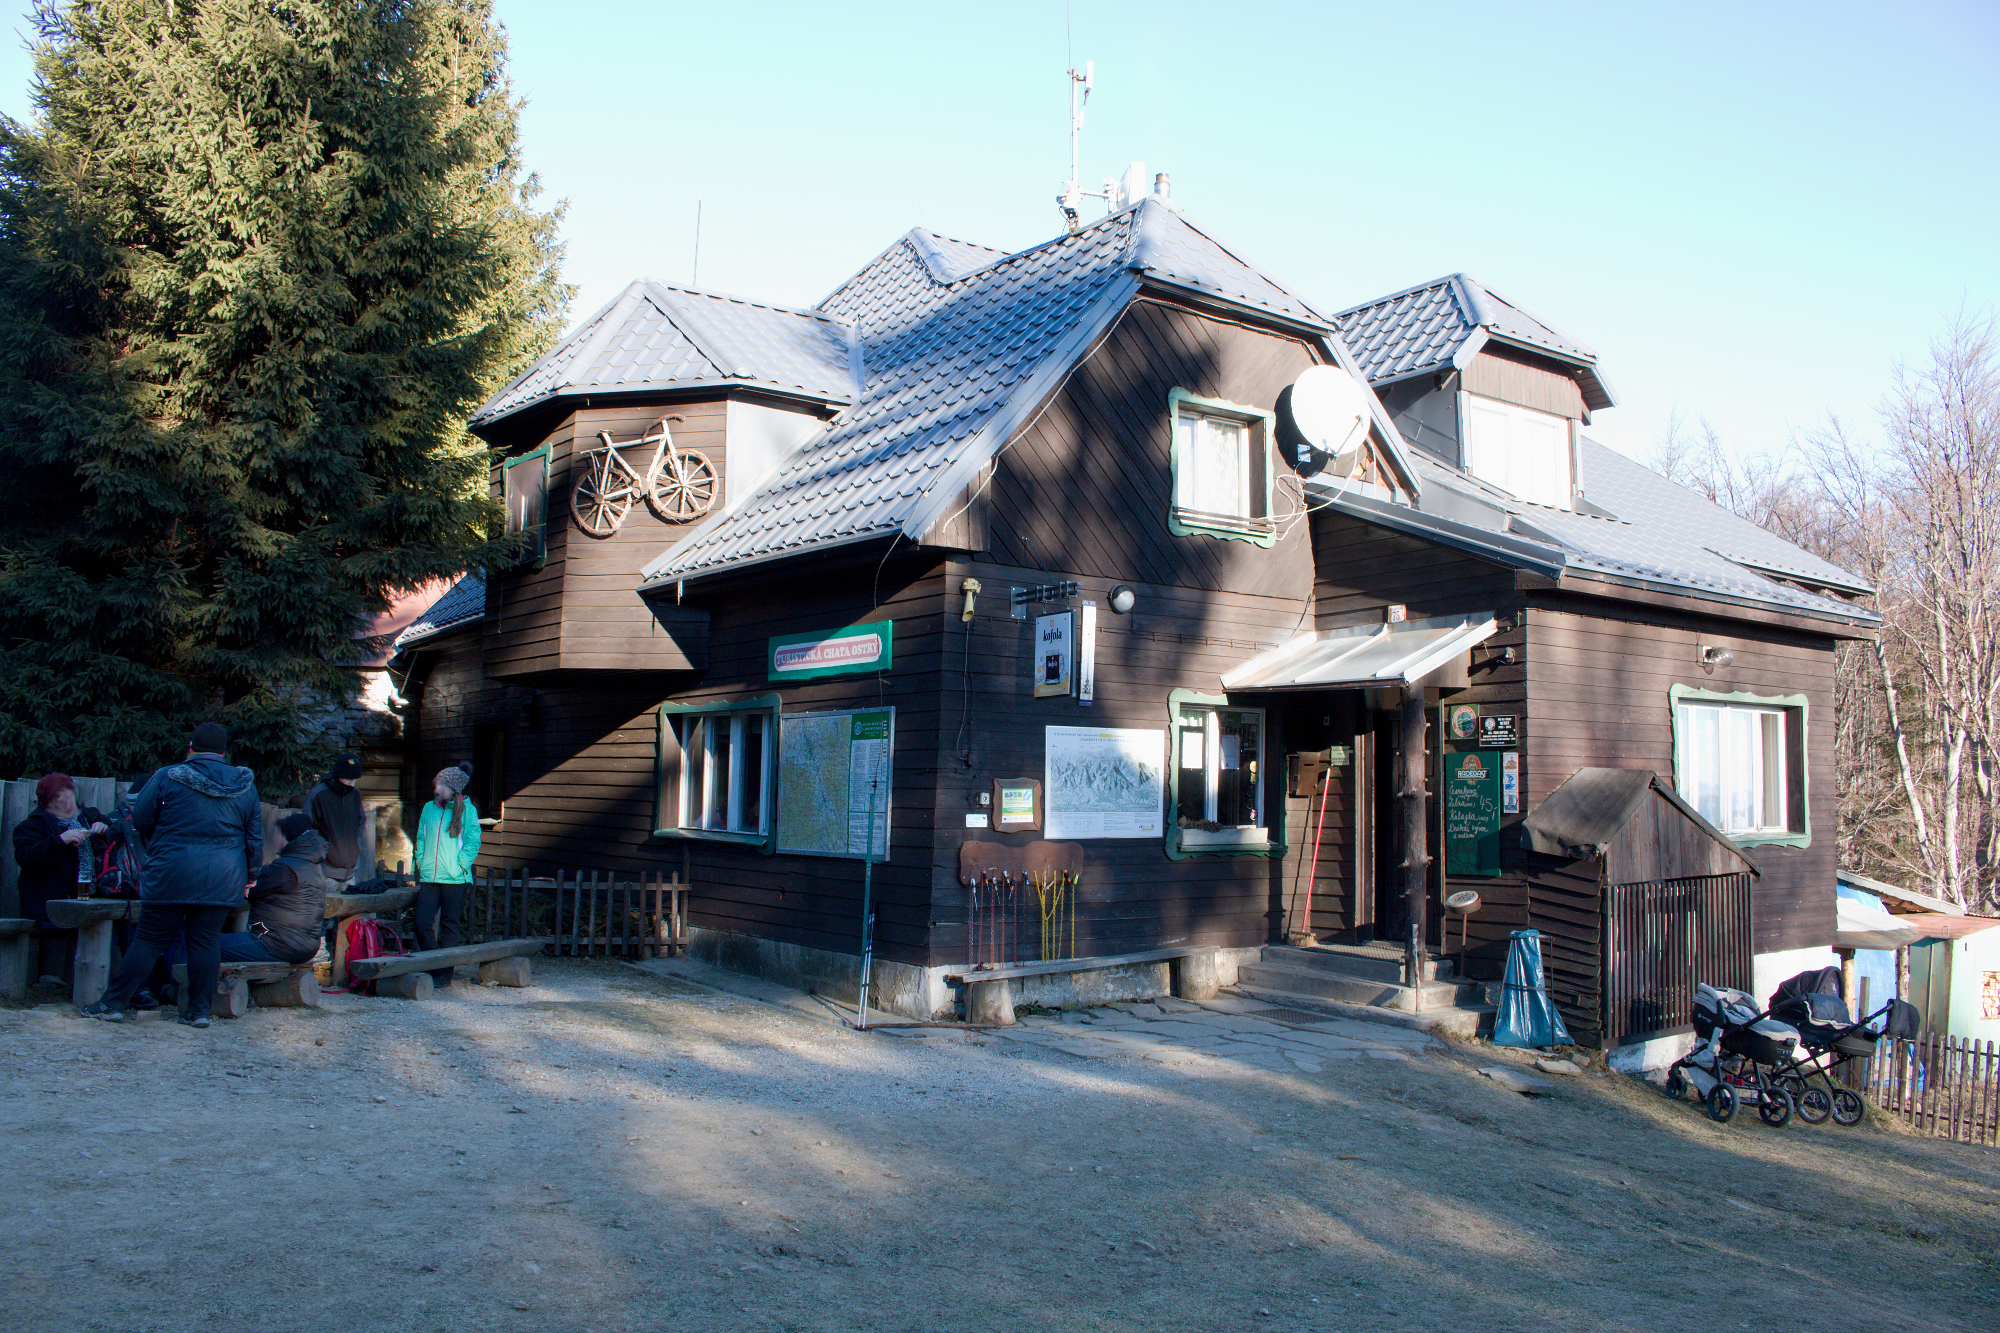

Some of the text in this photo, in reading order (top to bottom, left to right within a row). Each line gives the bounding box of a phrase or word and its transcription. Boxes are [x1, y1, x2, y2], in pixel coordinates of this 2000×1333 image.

[1042, 627, 1062, 645] kofola
[776, 639, 879, 665] TURISTICKÁ CHATA OSTRÝ
[1457, 770, 1488, 779] RADEGAST
